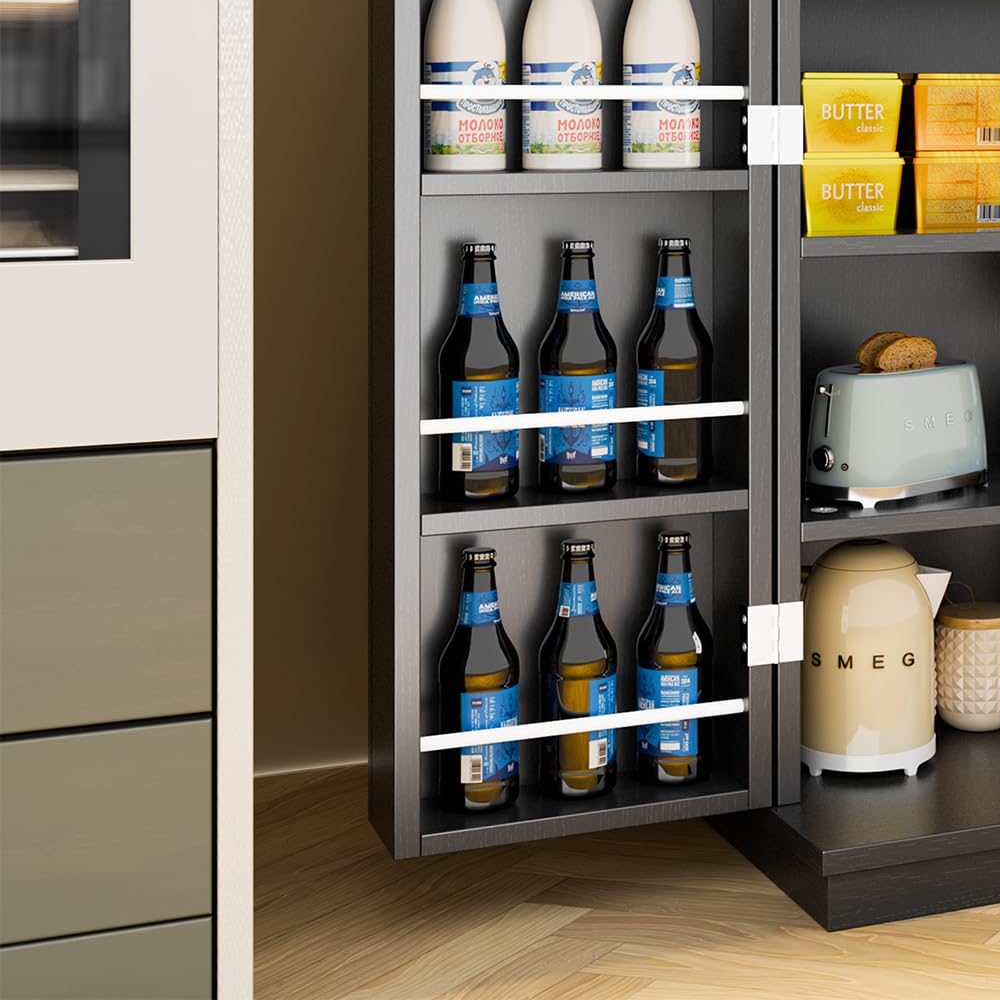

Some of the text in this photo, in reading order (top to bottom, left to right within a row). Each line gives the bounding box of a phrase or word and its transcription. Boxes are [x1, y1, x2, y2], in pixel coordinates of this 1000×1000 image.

[821, 103, 884, 120] BUTTER
[459, 118, 503, 131] МОЛОКО
[557, 118, 600, 131] МОЛОКО
[856, 122, 884, 133] classic
[459, 132, 503, 143] ОТБОРНОЕ
[821, 183, 884, 200] BUTTER
[856, 202, 884, 212] classic
[904, 409, 973, 432] SMEG
[811, 652, 915, 669] SMEG
